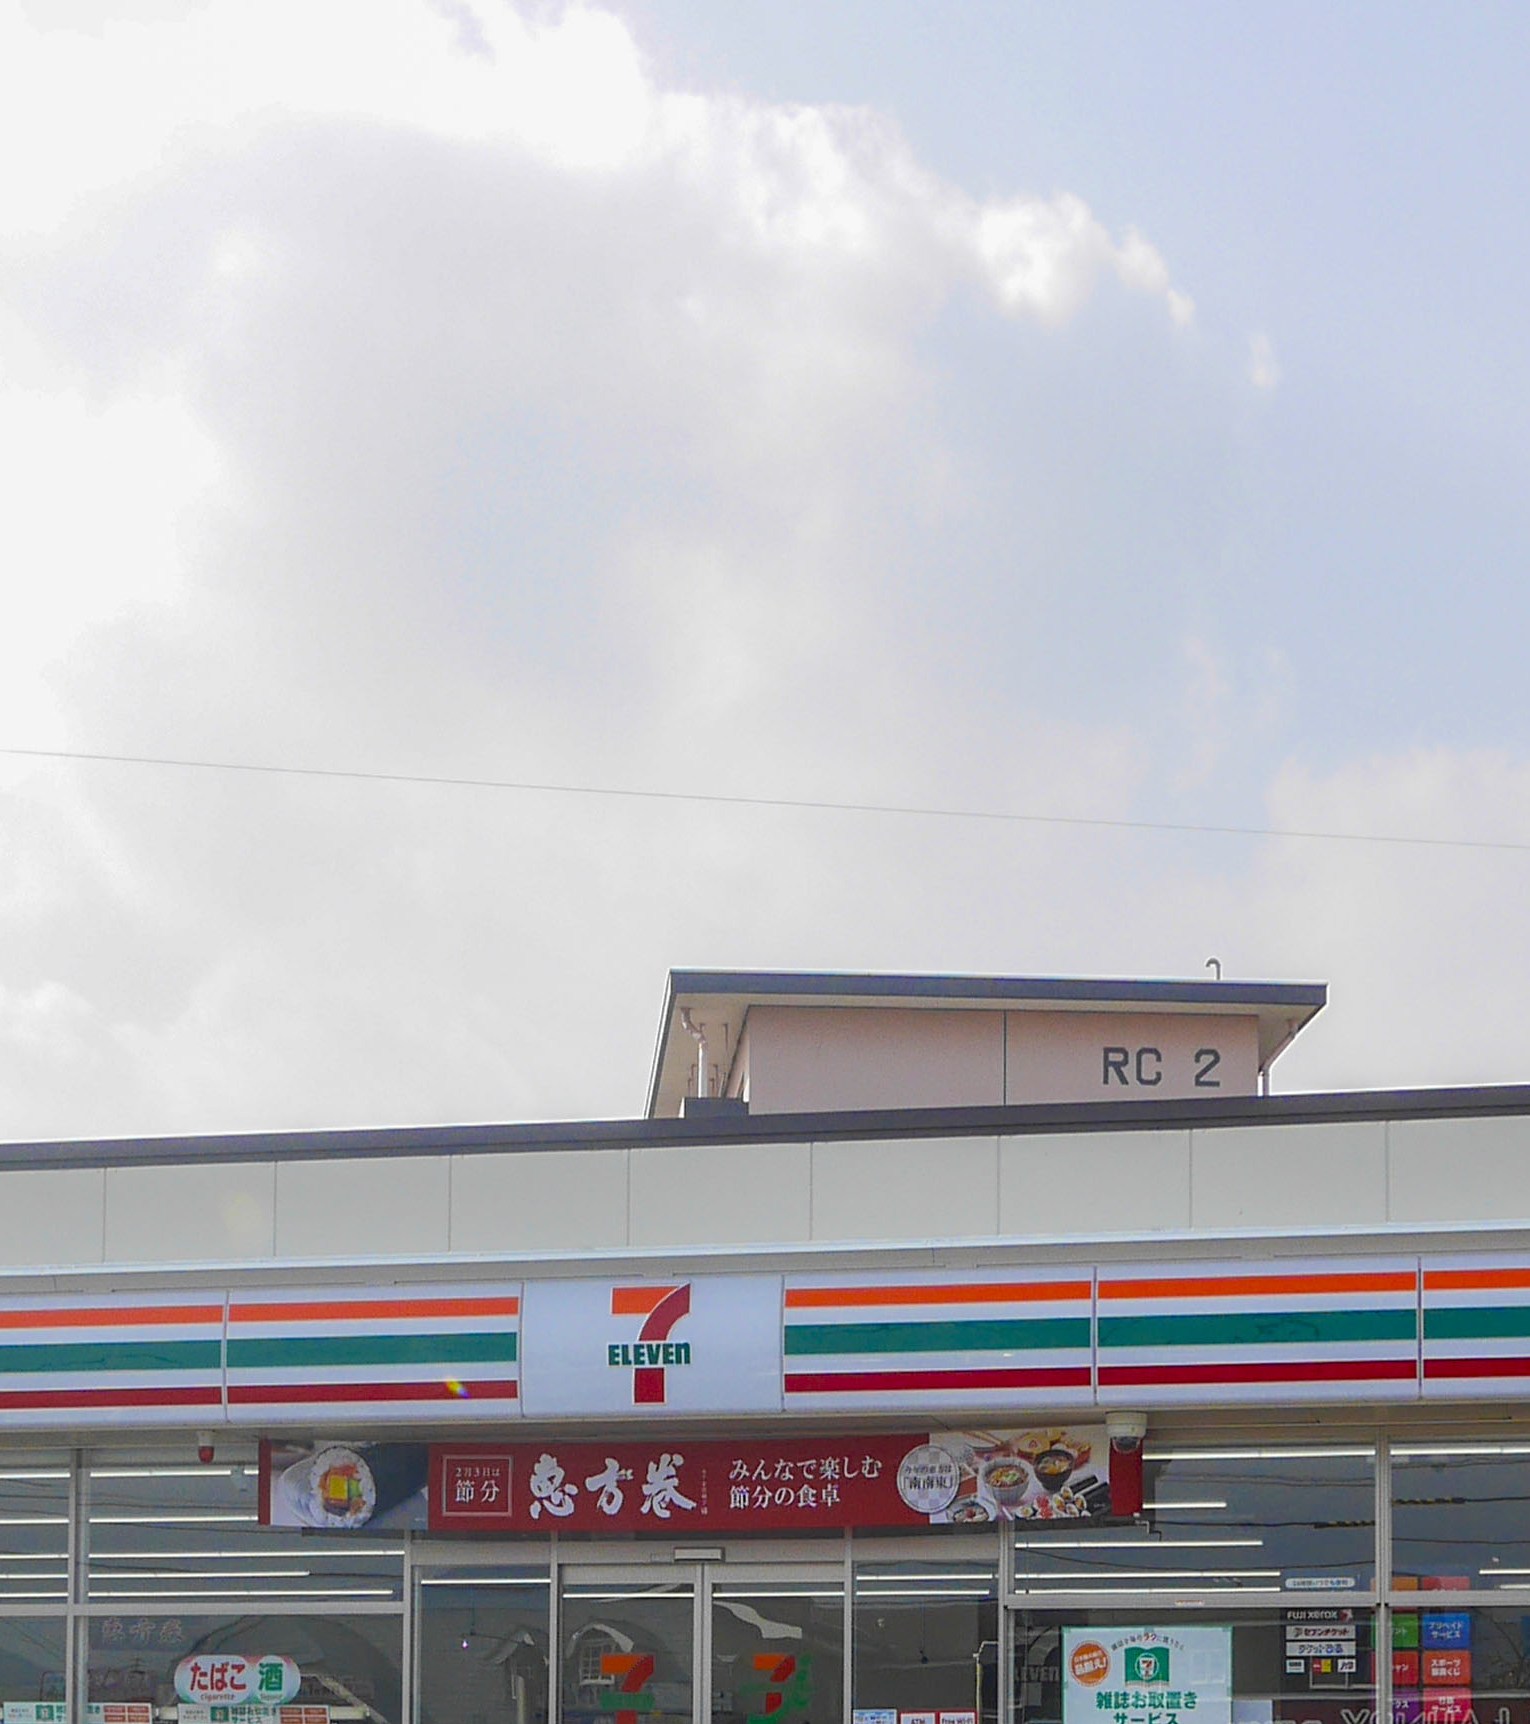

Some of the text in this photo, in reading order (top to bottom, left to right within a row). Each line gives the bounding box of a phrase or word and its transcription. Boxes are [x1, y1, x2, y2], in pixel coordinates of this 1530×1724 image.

[1103, 1047, 1220, 1087] RC 2
[455, 1466, 501, 1478] 2月3日は
[729, 1454, 883, 1482] みんなで楽しむ
[455, 1479, 501, 1503] 節分
[529, 1453, 698, 1520] 恵方巻
[729, 1484, 841, 1510] 節分の食卓
[190, 1661, 283, 1691] たばこ 酒
[1096, 1691, 1198, 1709] 雑誌お取置き
